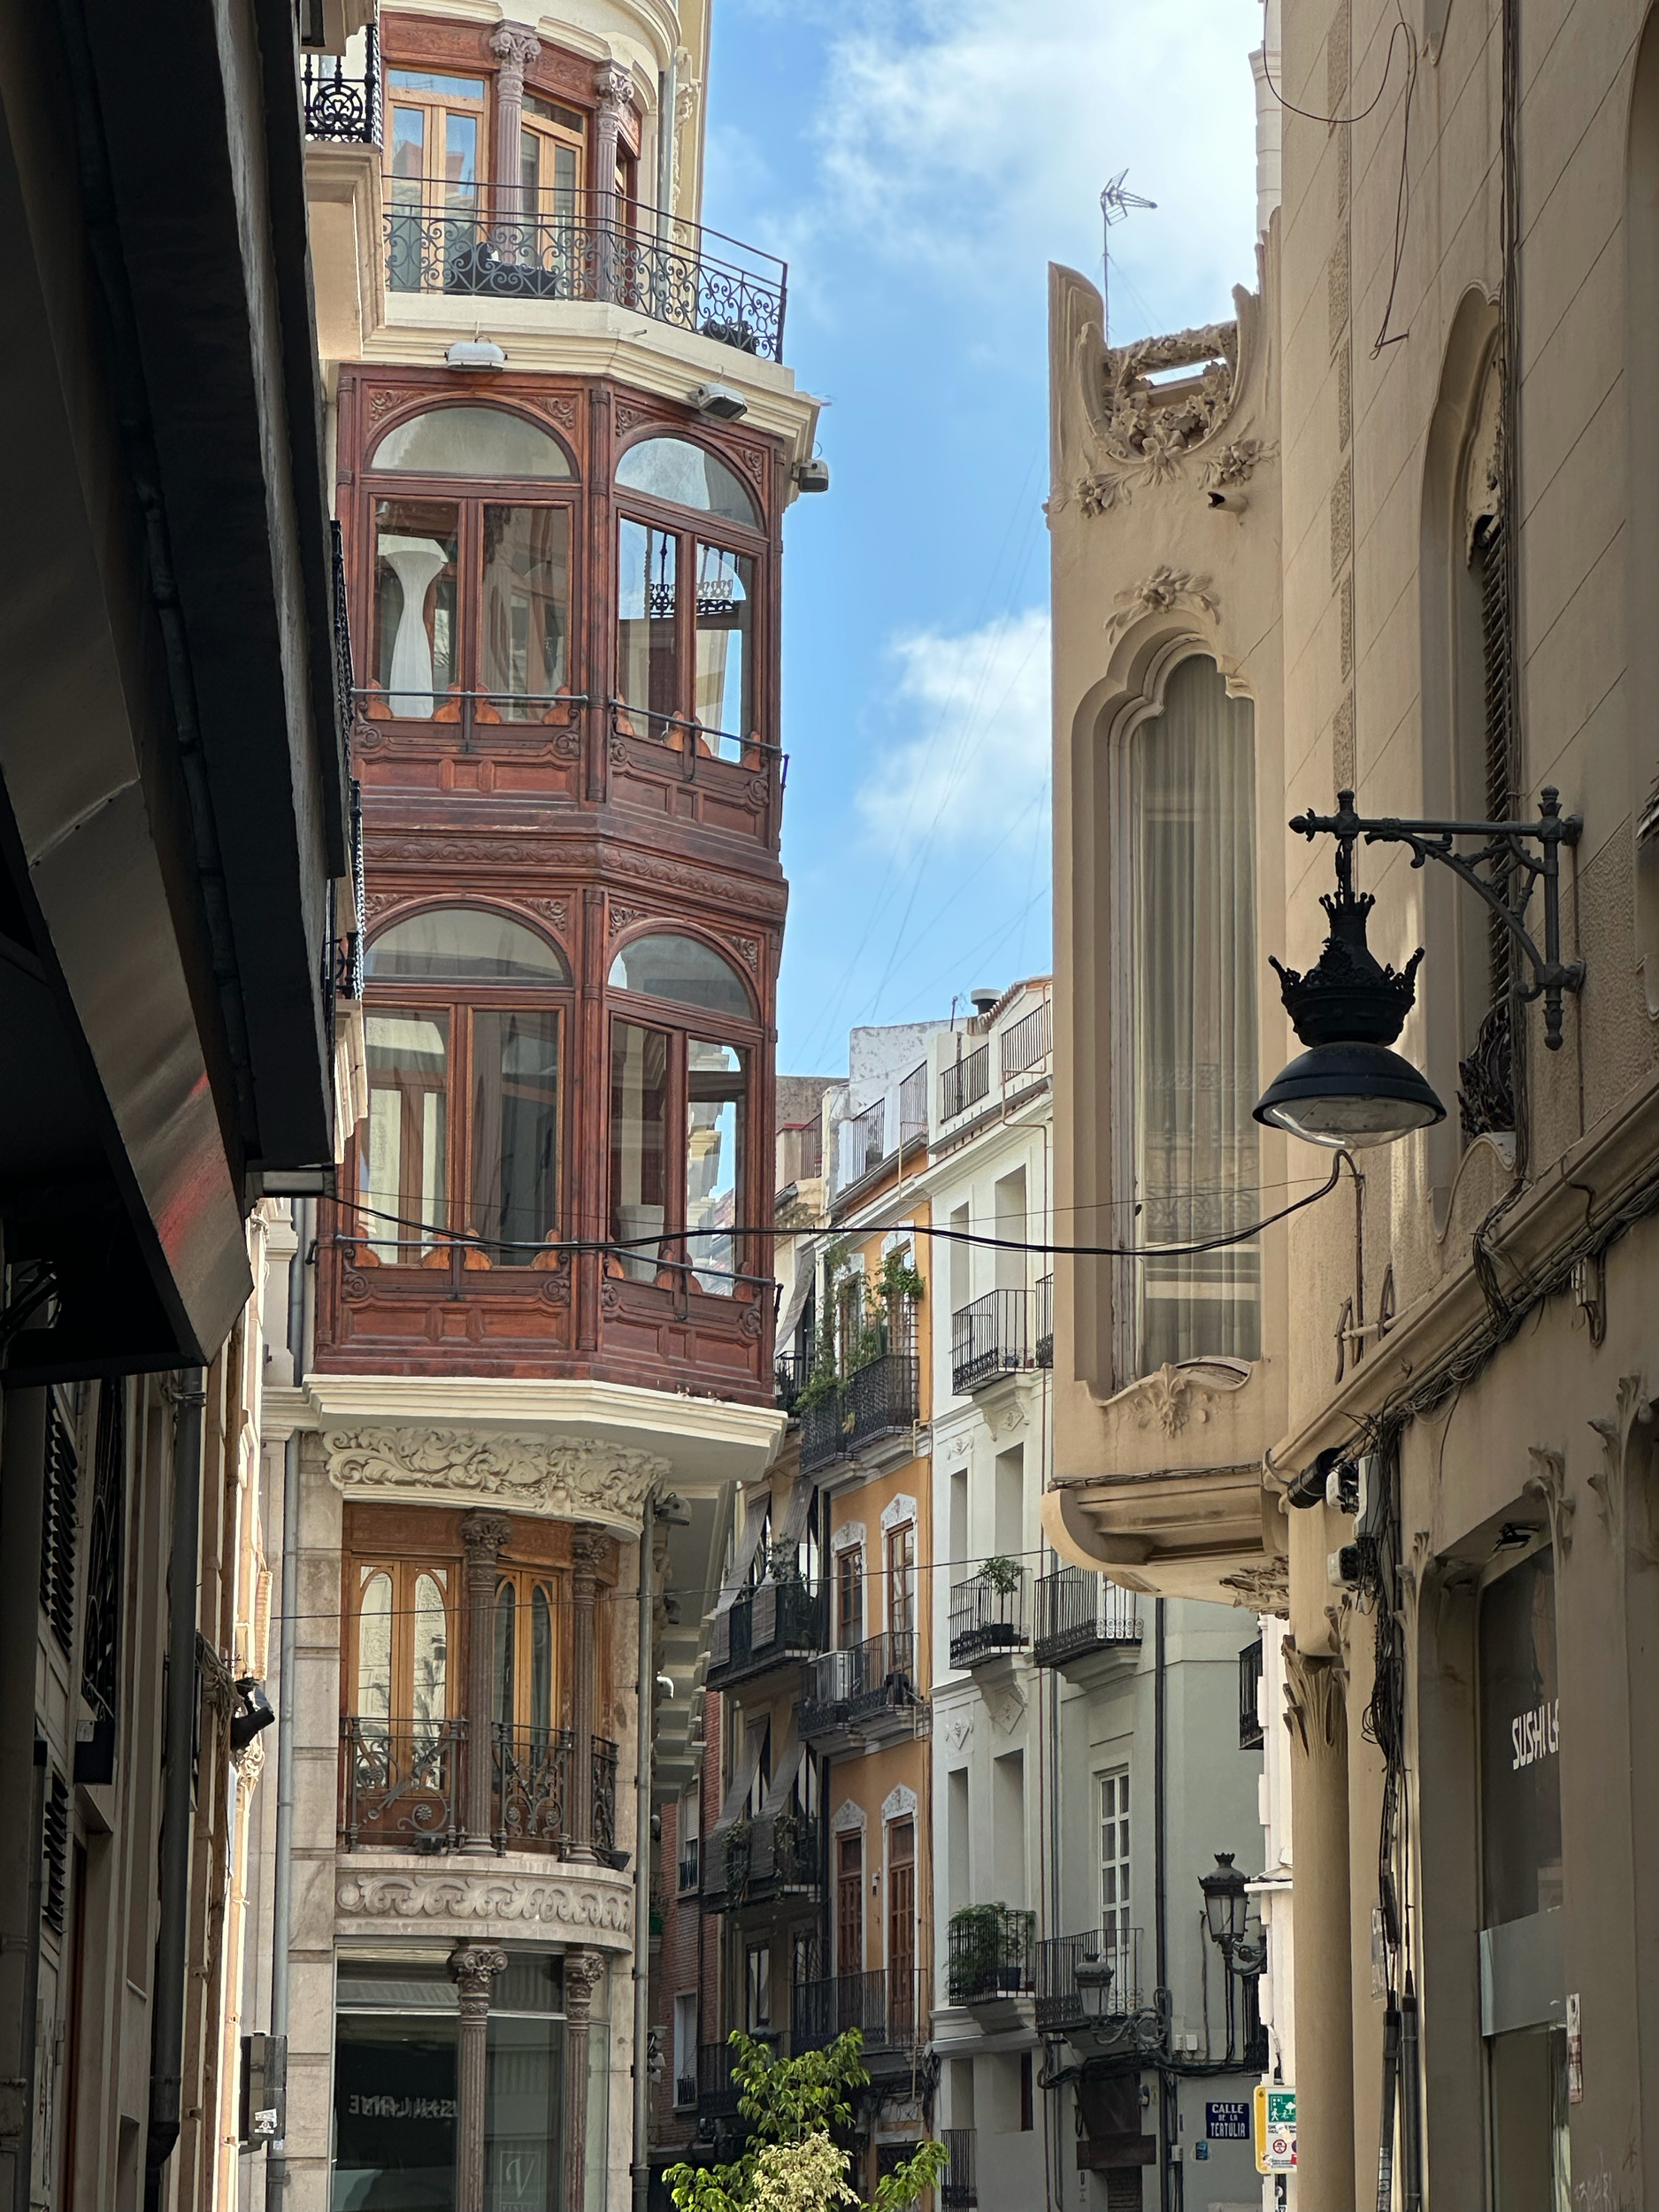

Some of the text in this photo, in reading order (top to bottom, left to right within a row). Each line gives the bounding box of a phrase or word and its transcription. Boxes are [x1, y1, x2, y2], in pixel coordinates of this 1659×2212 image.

[1511, 1705, 1547, 1770] SUSHI
[1212, 2104, 1244, 2114] CALLE
[1210, 2123, 1245, 2137] TERTULIA
